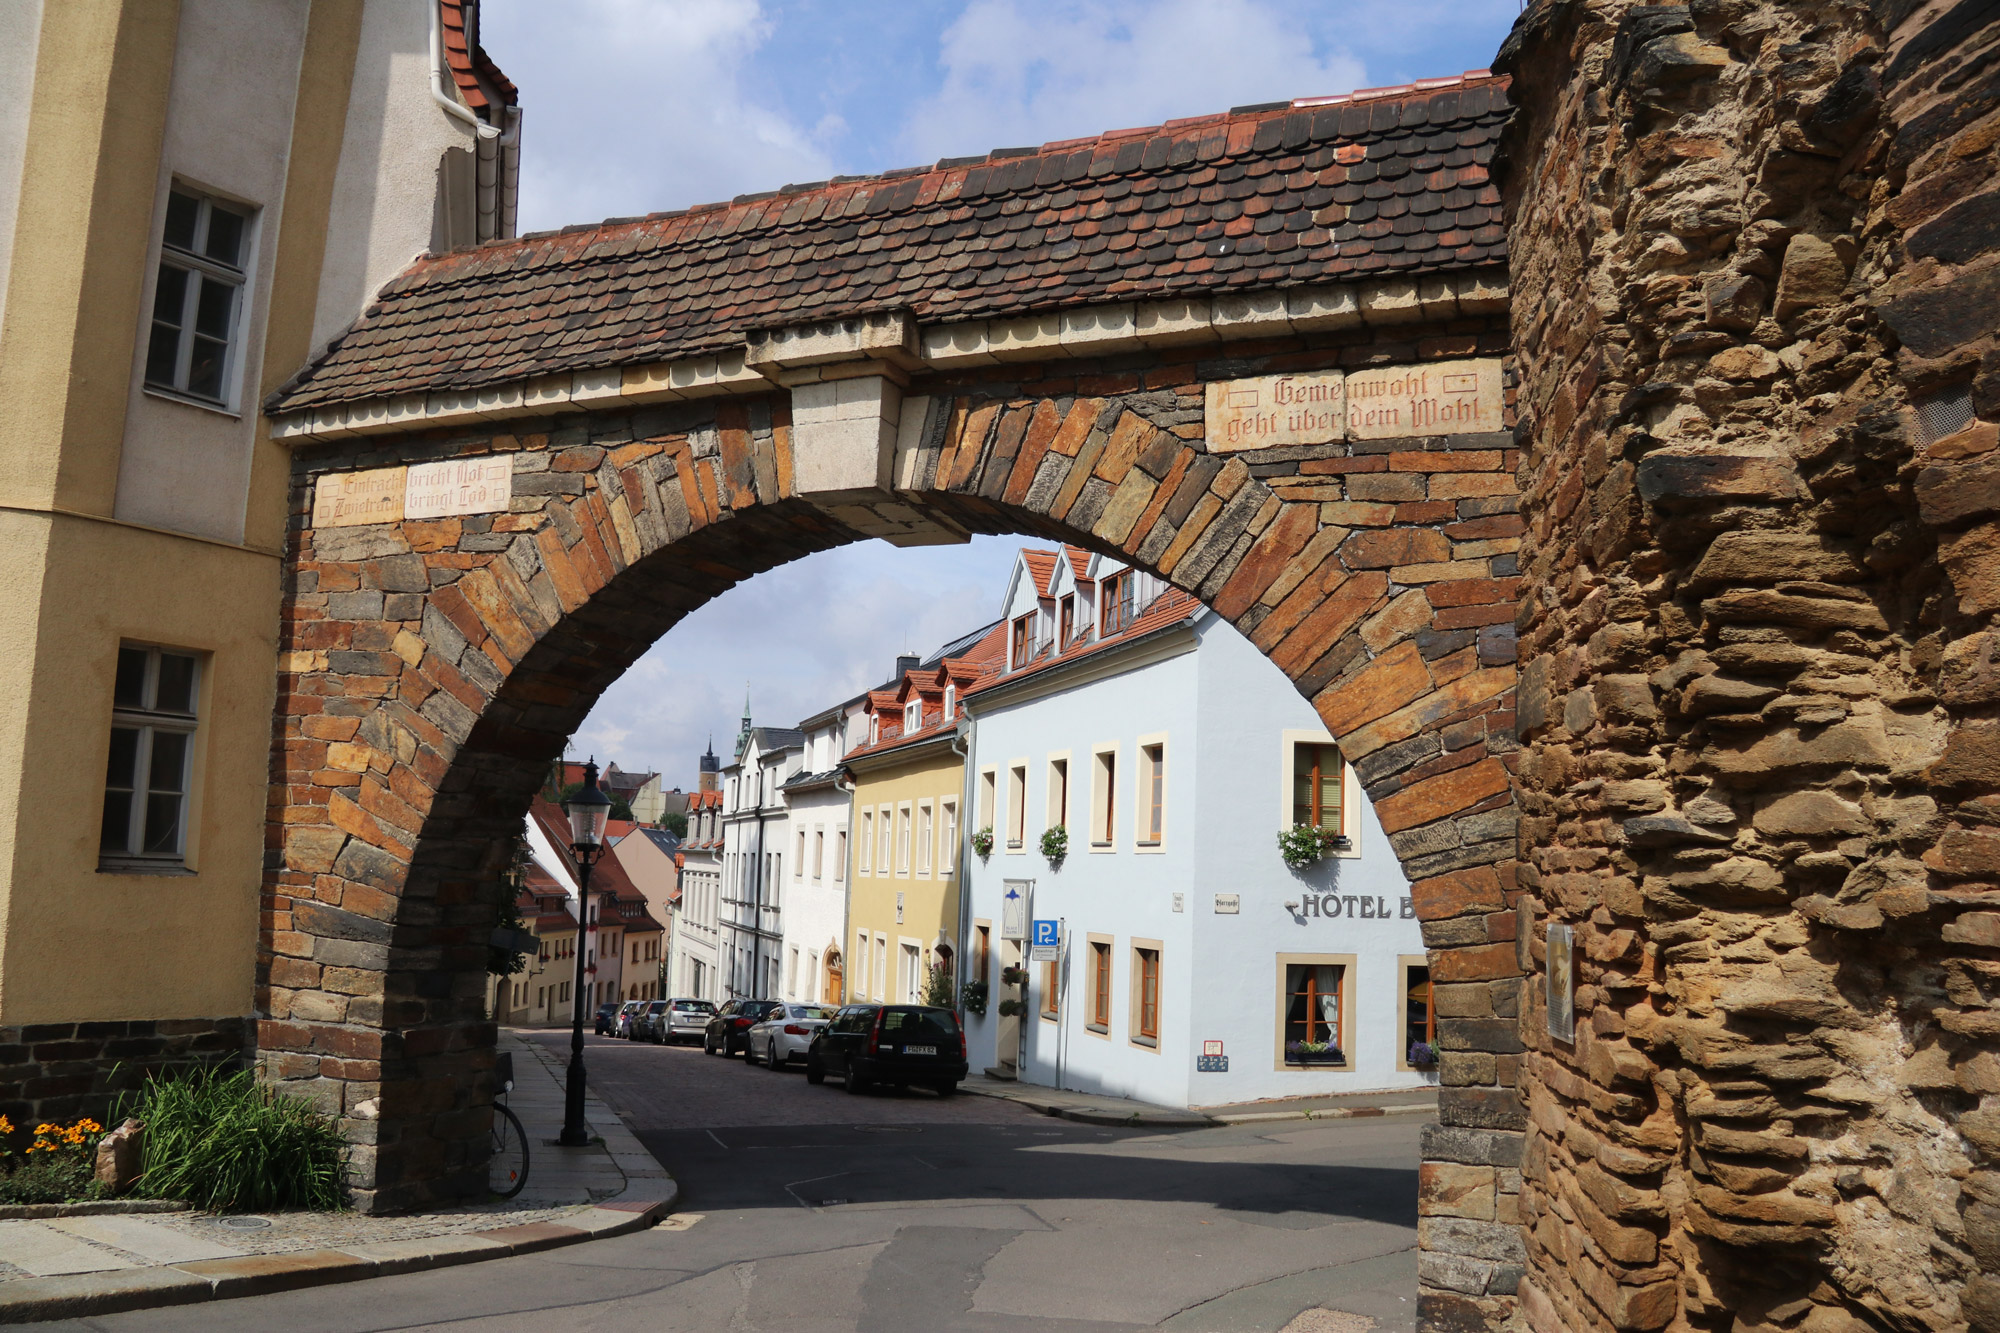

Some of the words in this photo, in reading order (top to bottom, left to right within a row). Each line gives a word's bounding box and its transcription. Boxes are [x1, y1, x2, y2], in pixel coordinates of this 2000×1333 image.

[1274, 370, 1428, 405] Gemeinwohl
[1227, 412, 1277, 442] geht
[1288, 408, 1342, 432] über
[1350, 403, 1400, 428] dein
[1411, 397, 1481, 428] Wohl
[344, 473, 405, 495] Eintracht
[409, 468, 452, 488] bricht
[457, 462, 483, 485] Not
[334, 494, 404, 518] Zwietracht
[409, 490, 453, 510] bringt
[458, 486, 487, 507] Tod
[1302, 894, 1392, 919] HOTEL
[1038, 923, 1052, 943] P
